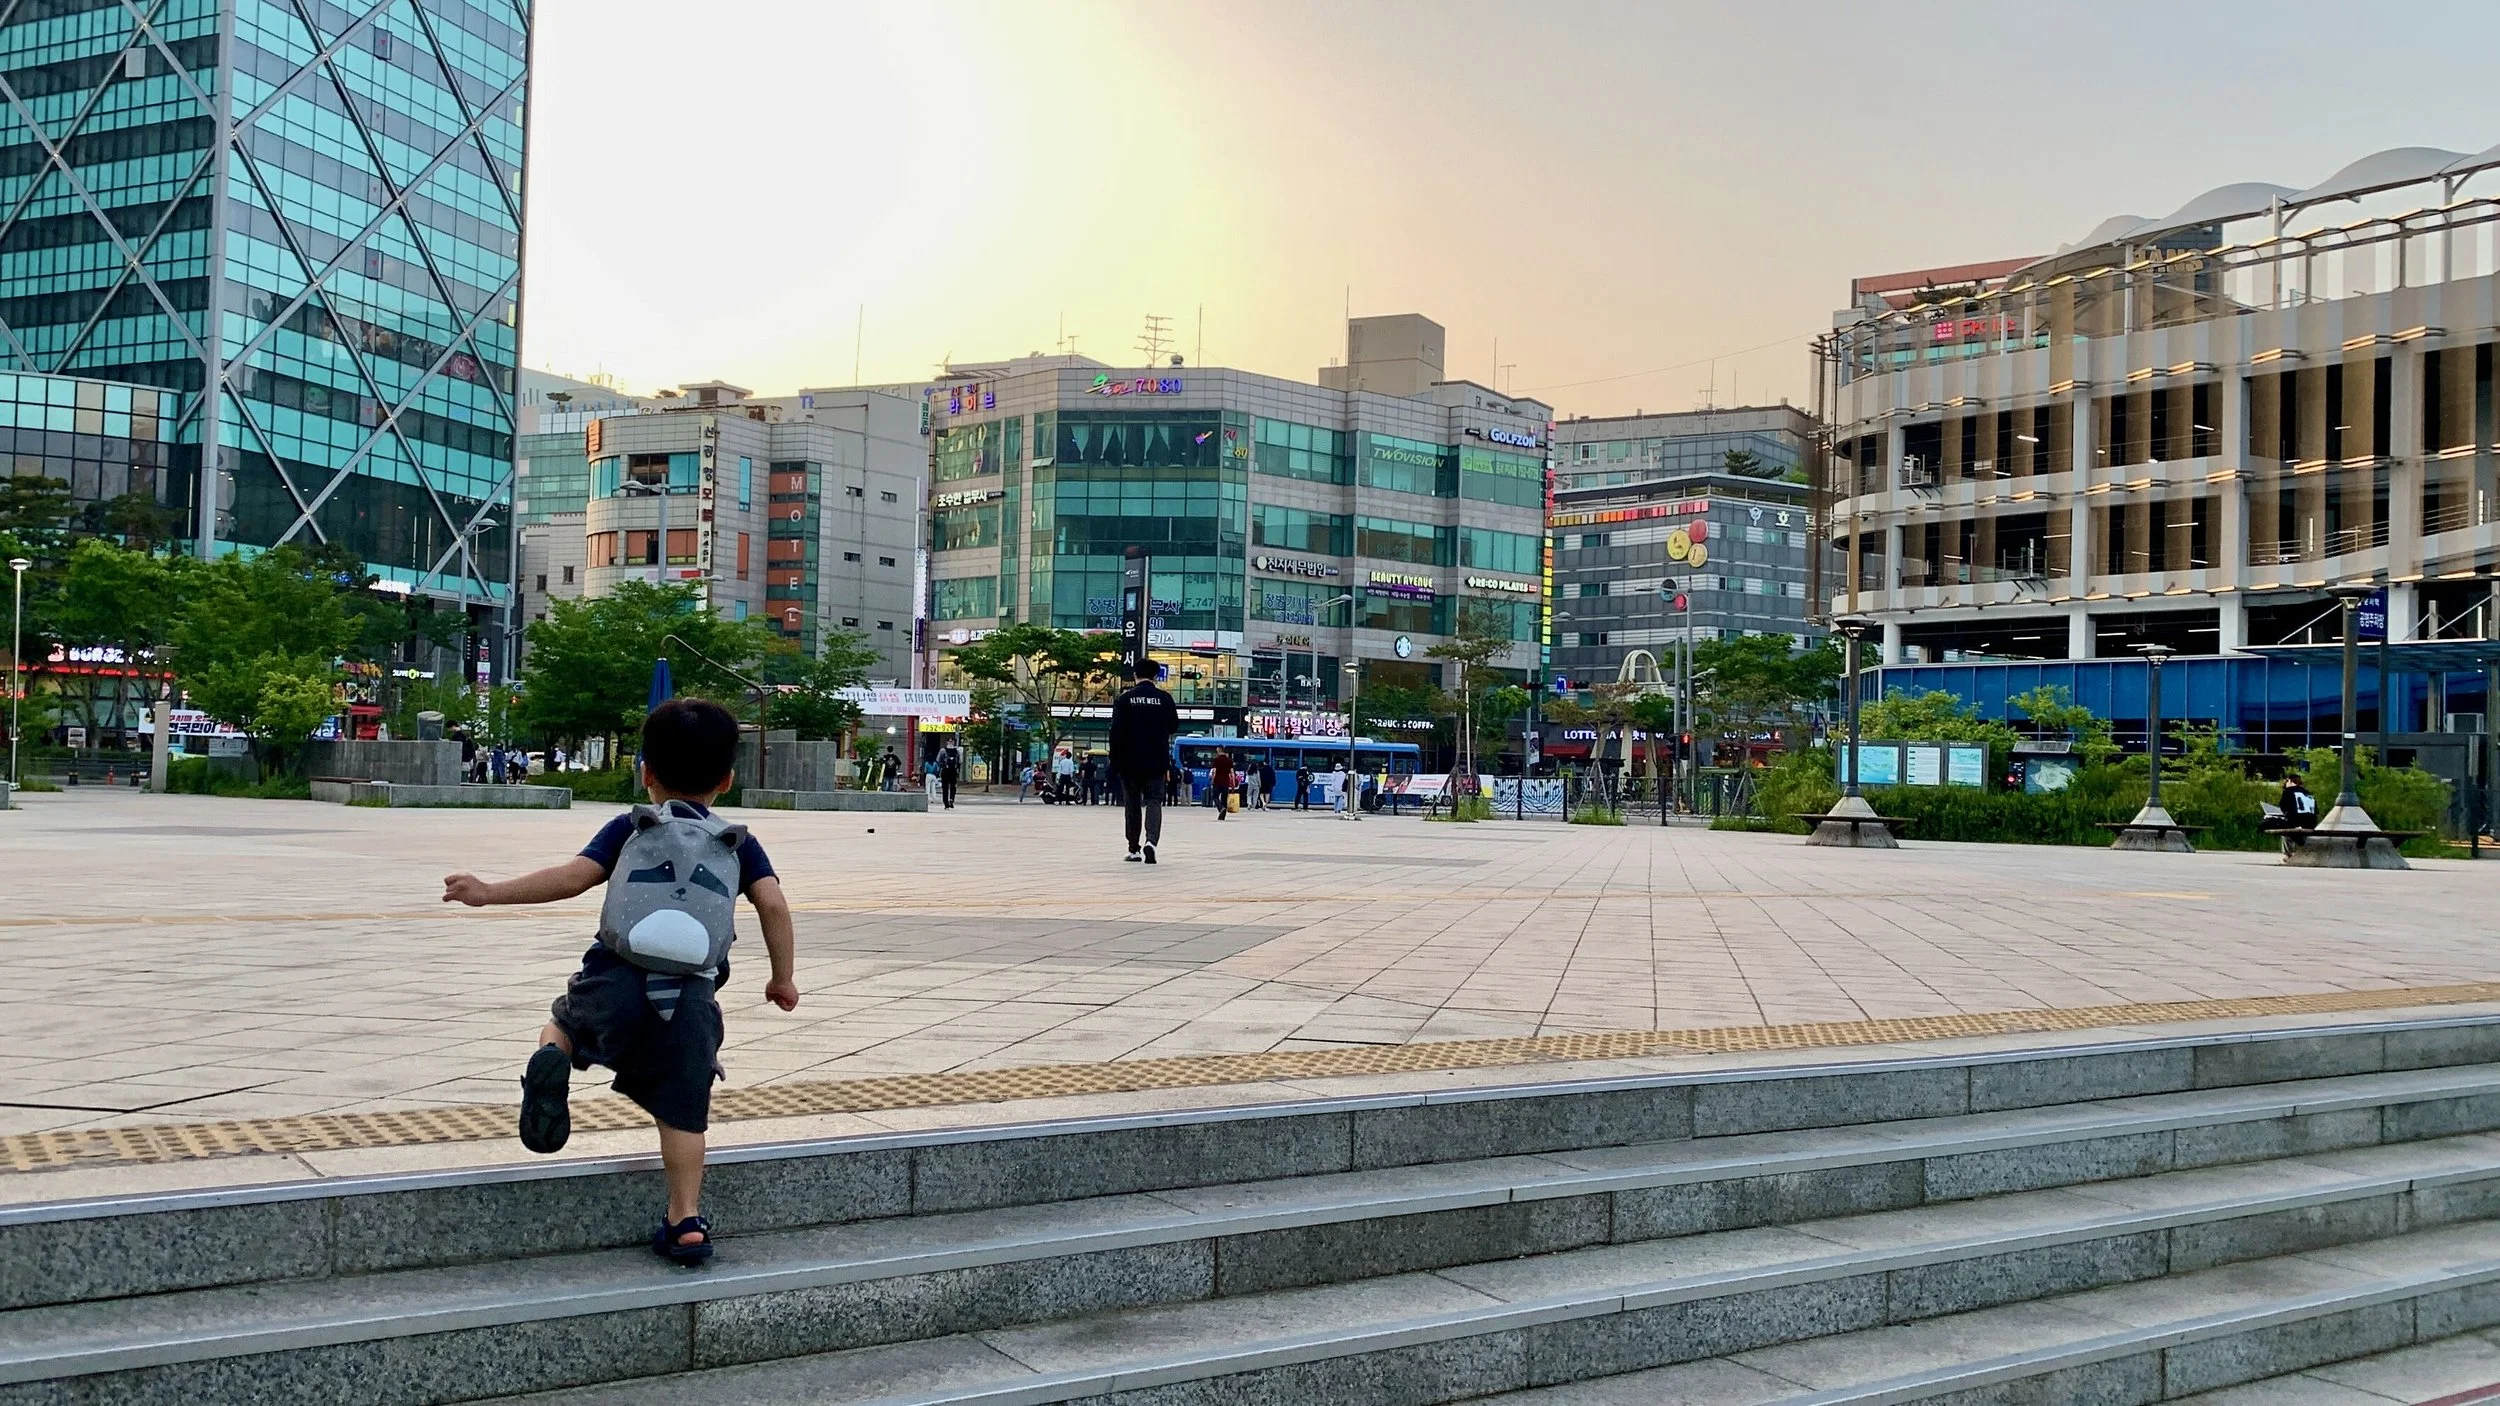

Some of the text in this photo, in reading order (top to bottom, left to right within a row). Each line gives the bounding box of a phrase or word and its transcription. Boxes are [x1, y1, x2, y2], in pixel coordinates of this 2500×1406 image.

[1135, 377, 1183, 394] 7080
[949, 391, 996, 415] 라이브
[1490, 427, 1537, 449] GOLFZON
[1374, 447, 1445, 469] TWOVISION
[963, 488, 988, 505] 법무사
[787, 475, 803, 622] MOTEL
[1370, 571, 1433, 588] BEAUTY AVENUE
[1499, 579, 1529, 593] PILATES
[1146, 697, 1161, 705] WELL
[1564, 730, 1617, 740] LOTTEIA
